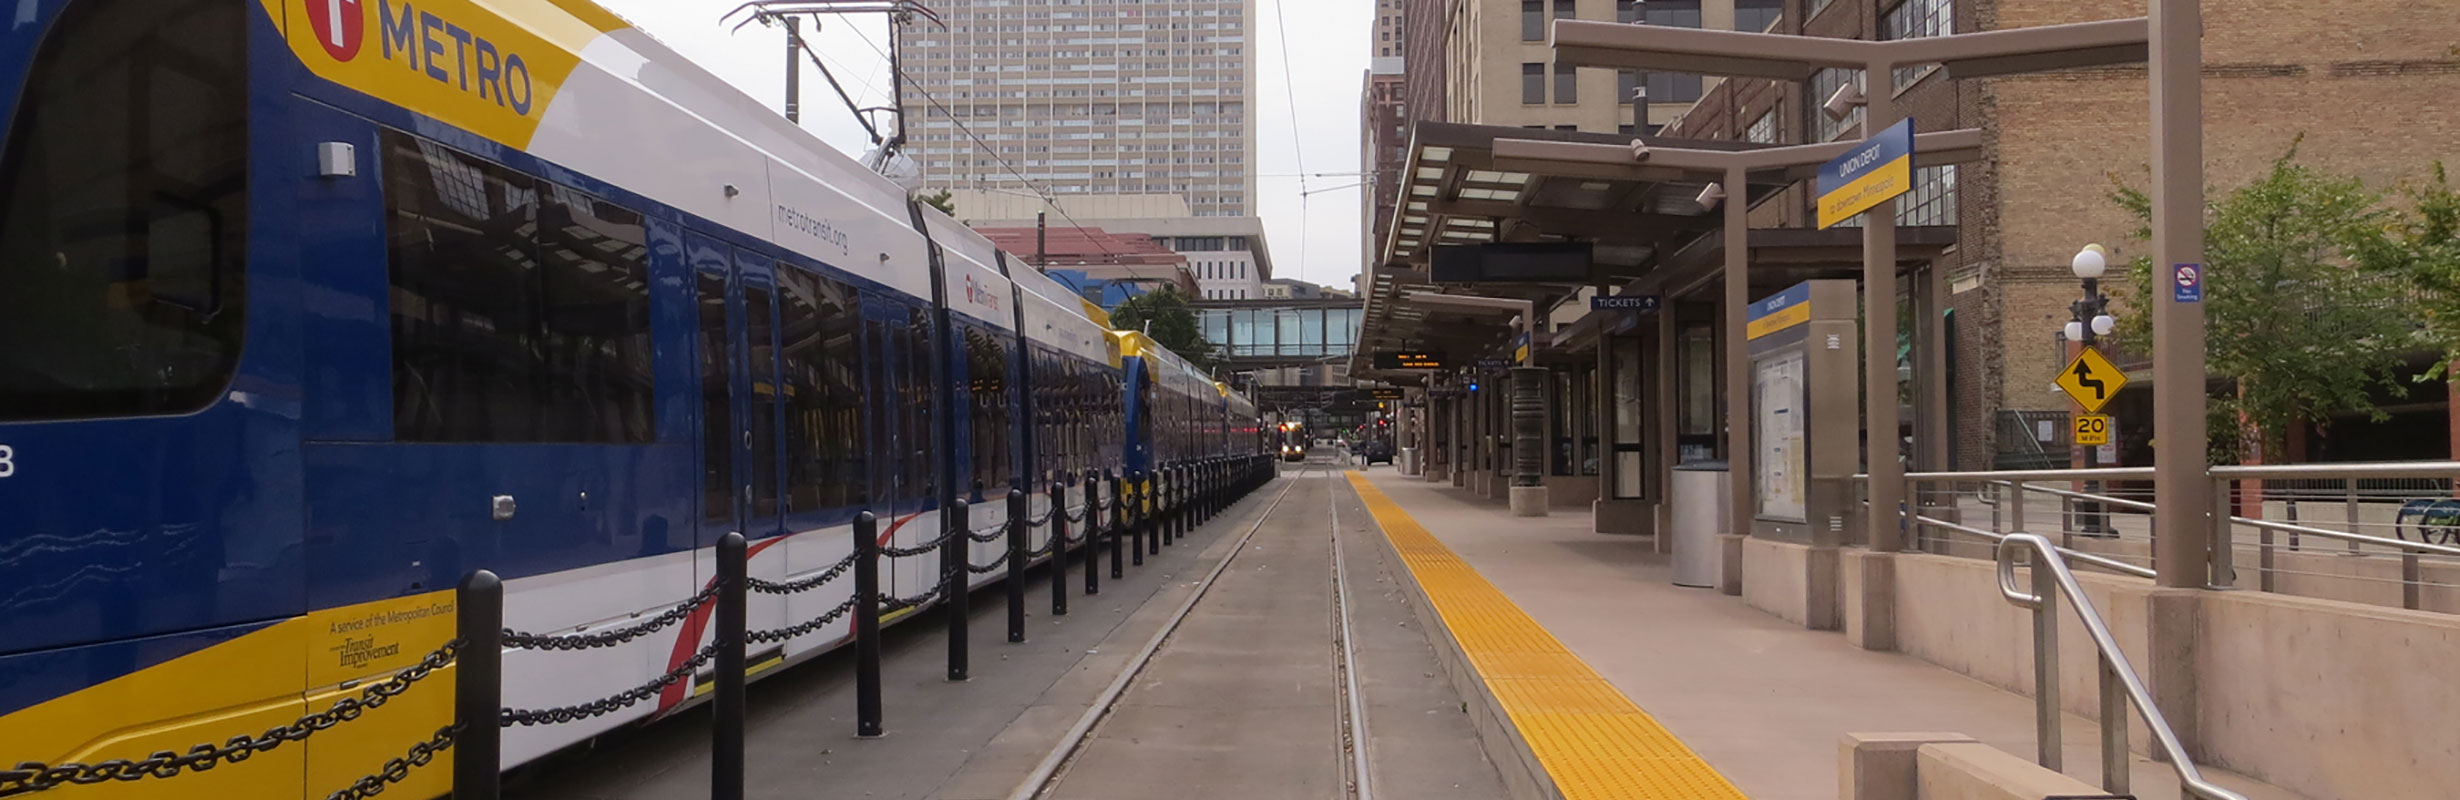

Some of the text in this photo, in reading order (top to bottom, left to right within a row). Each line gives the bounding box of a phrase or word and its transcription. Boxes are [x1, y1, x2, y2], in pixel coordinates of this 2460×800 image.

[378, 0, 532, 116] METRO
[1840, 143, 1881, 178] UNION DEPOT
[778, 204, 848, 256] metrotransit.org
[1598, 298, 1641, 308] TICKETS
[2078, 418, 2104, 433] 20
[329, 602, 455, 634] A service of the Metropolitan Council
[340, 643, 400, 669] Improvement
[344, 633, 374, 653] Transit
